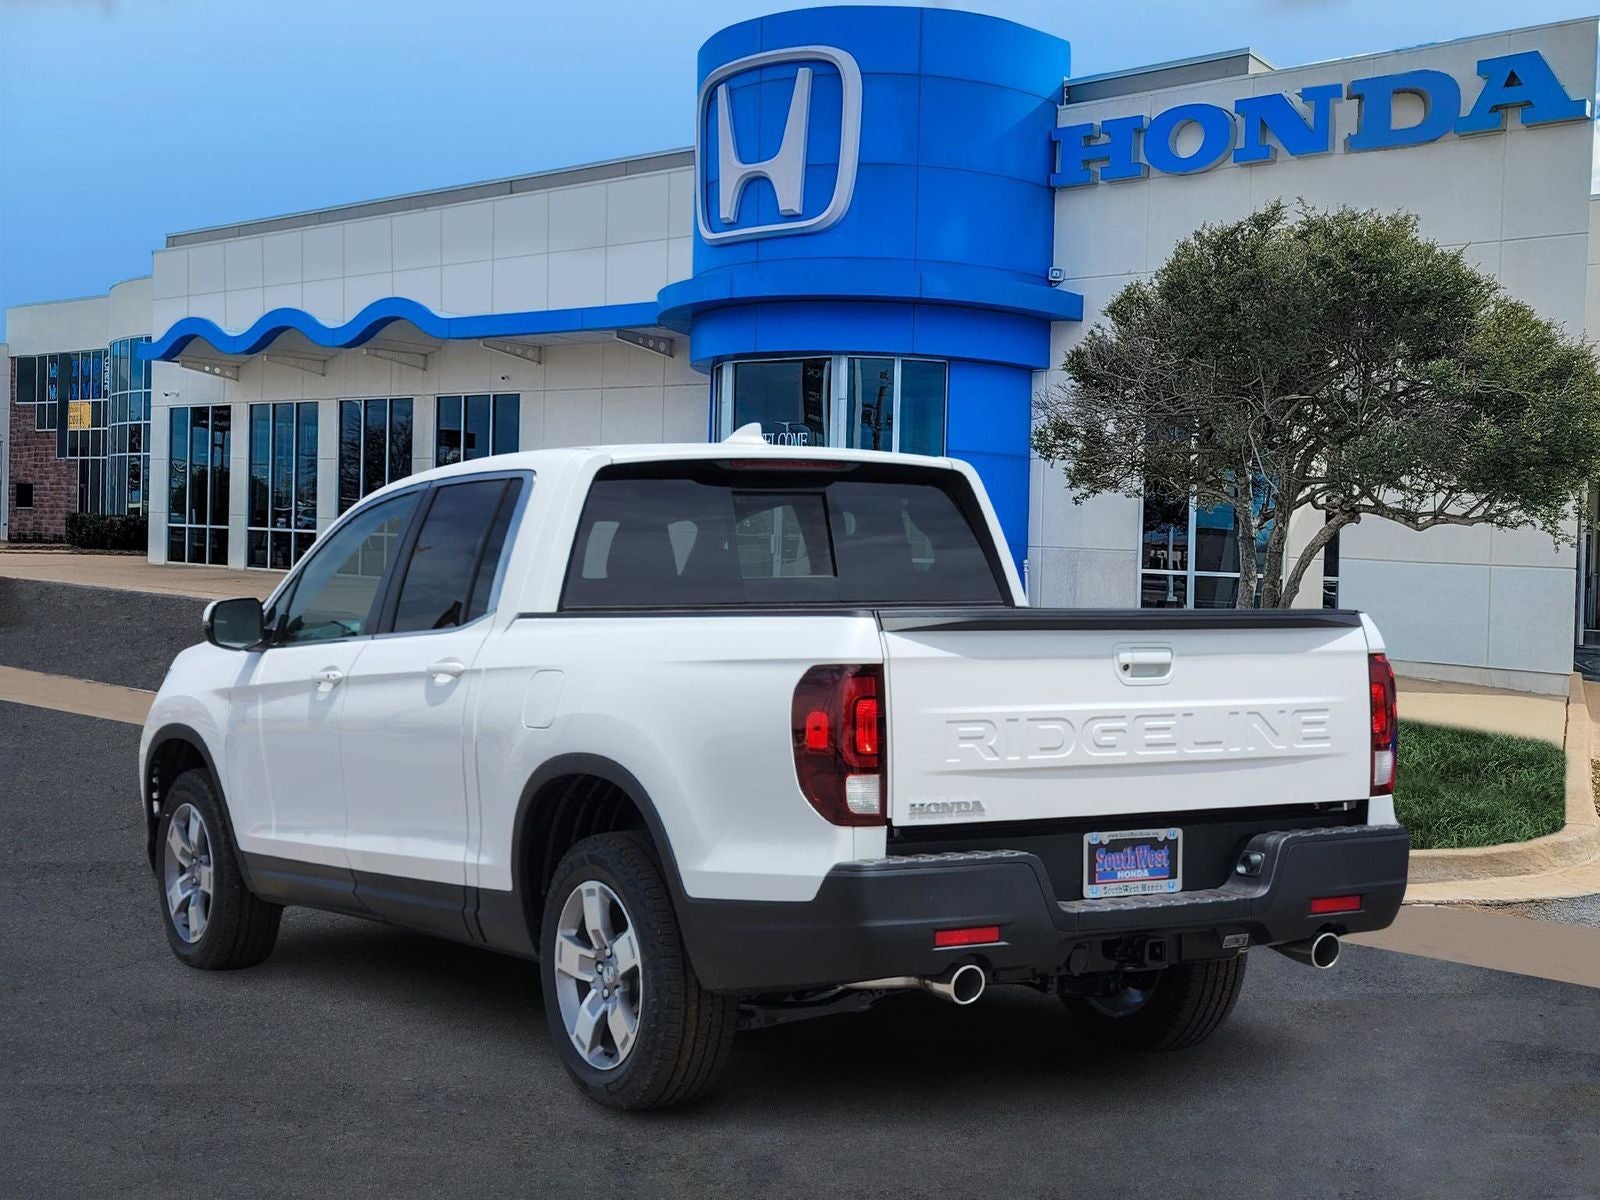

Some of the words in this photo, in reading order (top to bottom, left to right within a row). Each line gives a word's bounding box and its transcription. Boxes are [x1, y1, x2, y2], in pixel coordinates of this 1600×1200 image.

[1050, 49, 1592, 188] HONDA
[762, 432, 808, 446] ELCOME
[946, 707, 1332, 764] RIDGELINE
[908, 799, 986, 816] HONDA
[1117, 868, 1150, 879] HONDA
